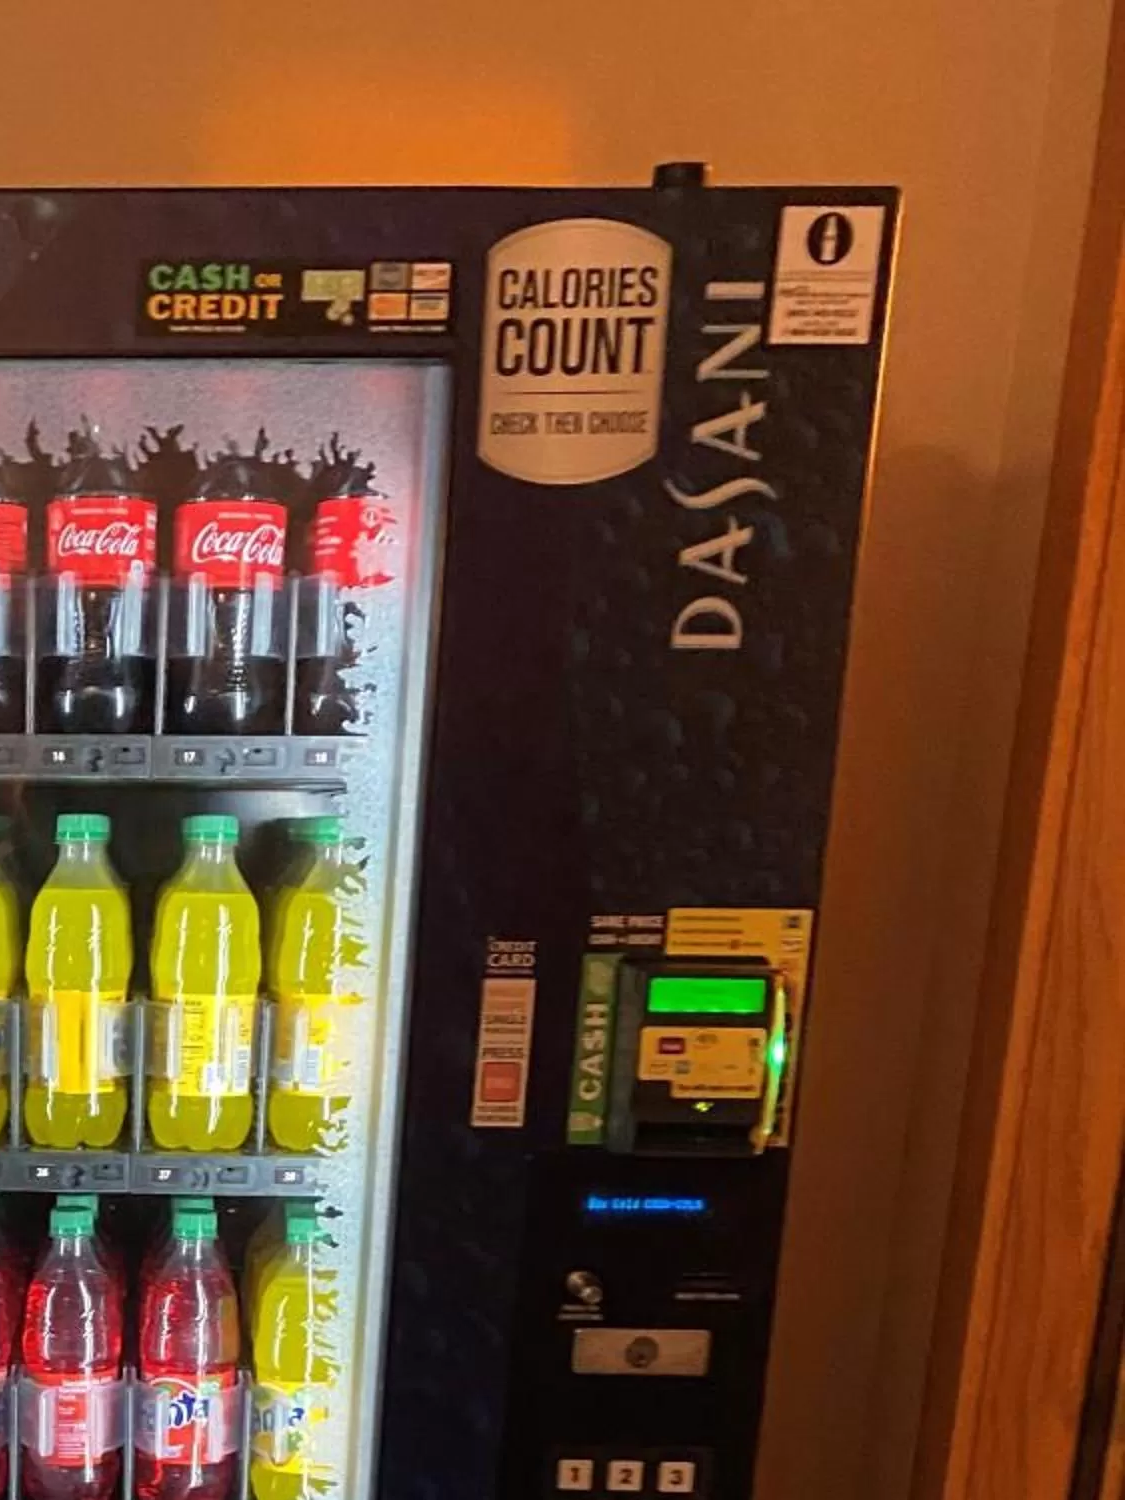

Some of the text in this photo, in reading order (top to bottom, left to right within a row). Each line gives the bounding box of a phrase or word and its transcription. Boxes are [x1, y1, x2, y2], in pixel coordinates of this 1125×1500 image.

[148, 263, 251, 291] CASH
[498, 266, 659, 310] CALORIES
[147, 294, 284, 320] CREDIT
[496, 317, 655, 376] COUNT
[663, 282, 777, 649] DASANI
[58, 521, 142, 557] Coca-Cola
[192, 521, 285, 566] Coca-Cola
[578, 1003, 610, 1101] CASH
[570, 1467, 683, 1485] 1 2 3
